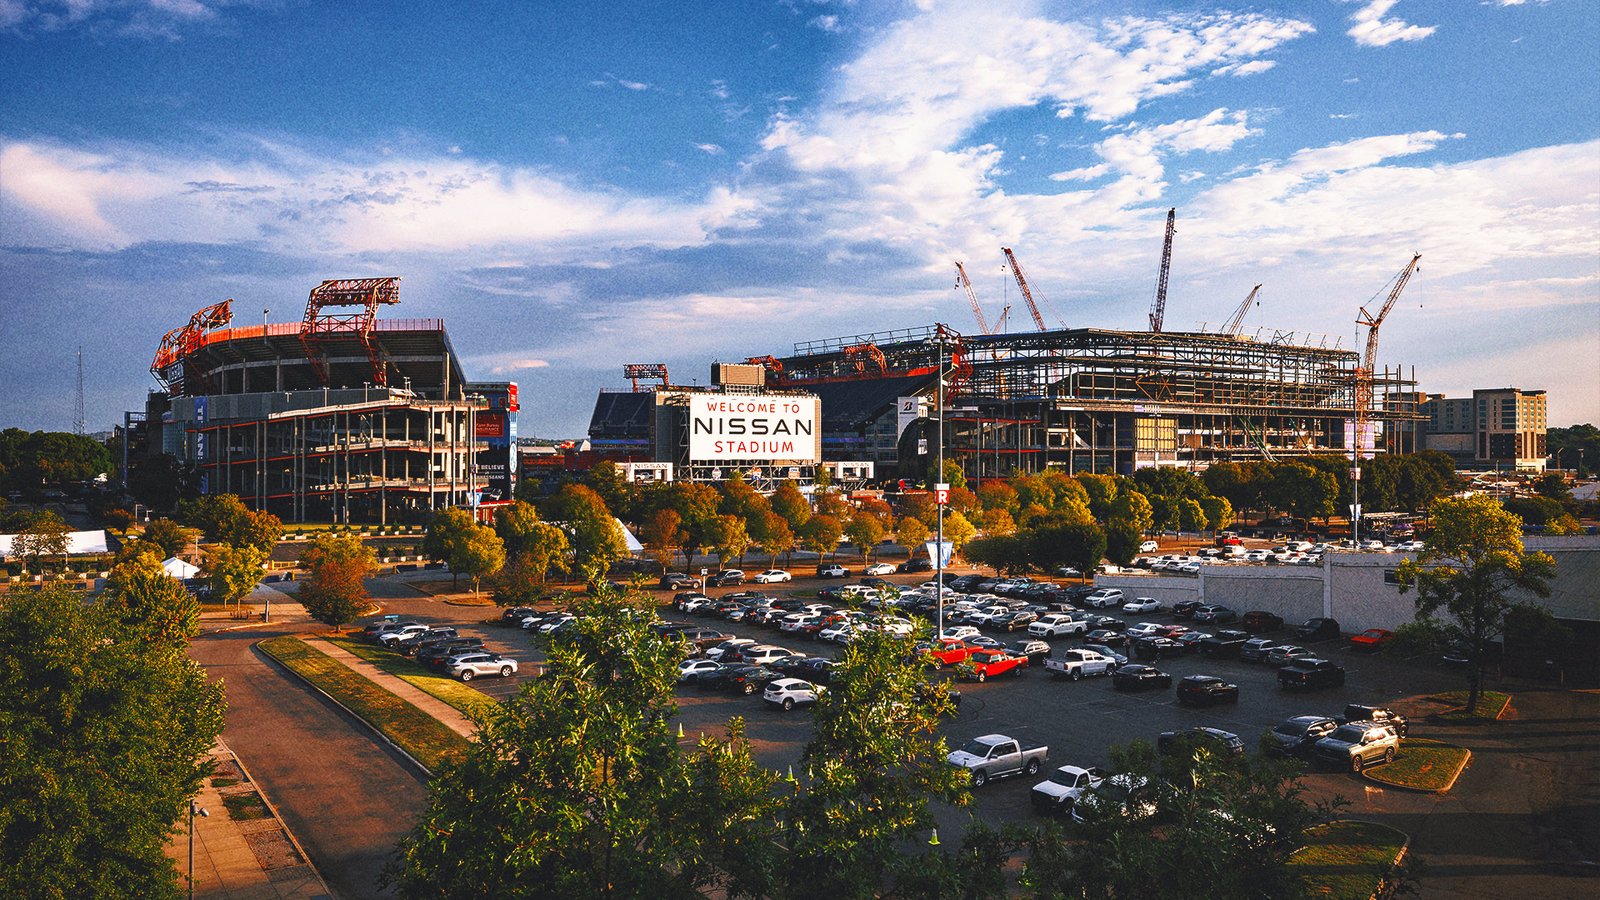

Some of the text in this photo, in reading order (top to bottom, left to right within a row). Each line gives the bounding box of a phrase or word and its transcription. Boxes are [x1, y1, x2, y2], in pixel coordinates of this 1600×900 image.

[707, 402, 800, 414] WELCOME TO
[694, 418, 812, 435] NISSAN
[714, 440, 794, 453] STADIUM
[938, 490, 948, 503] R
